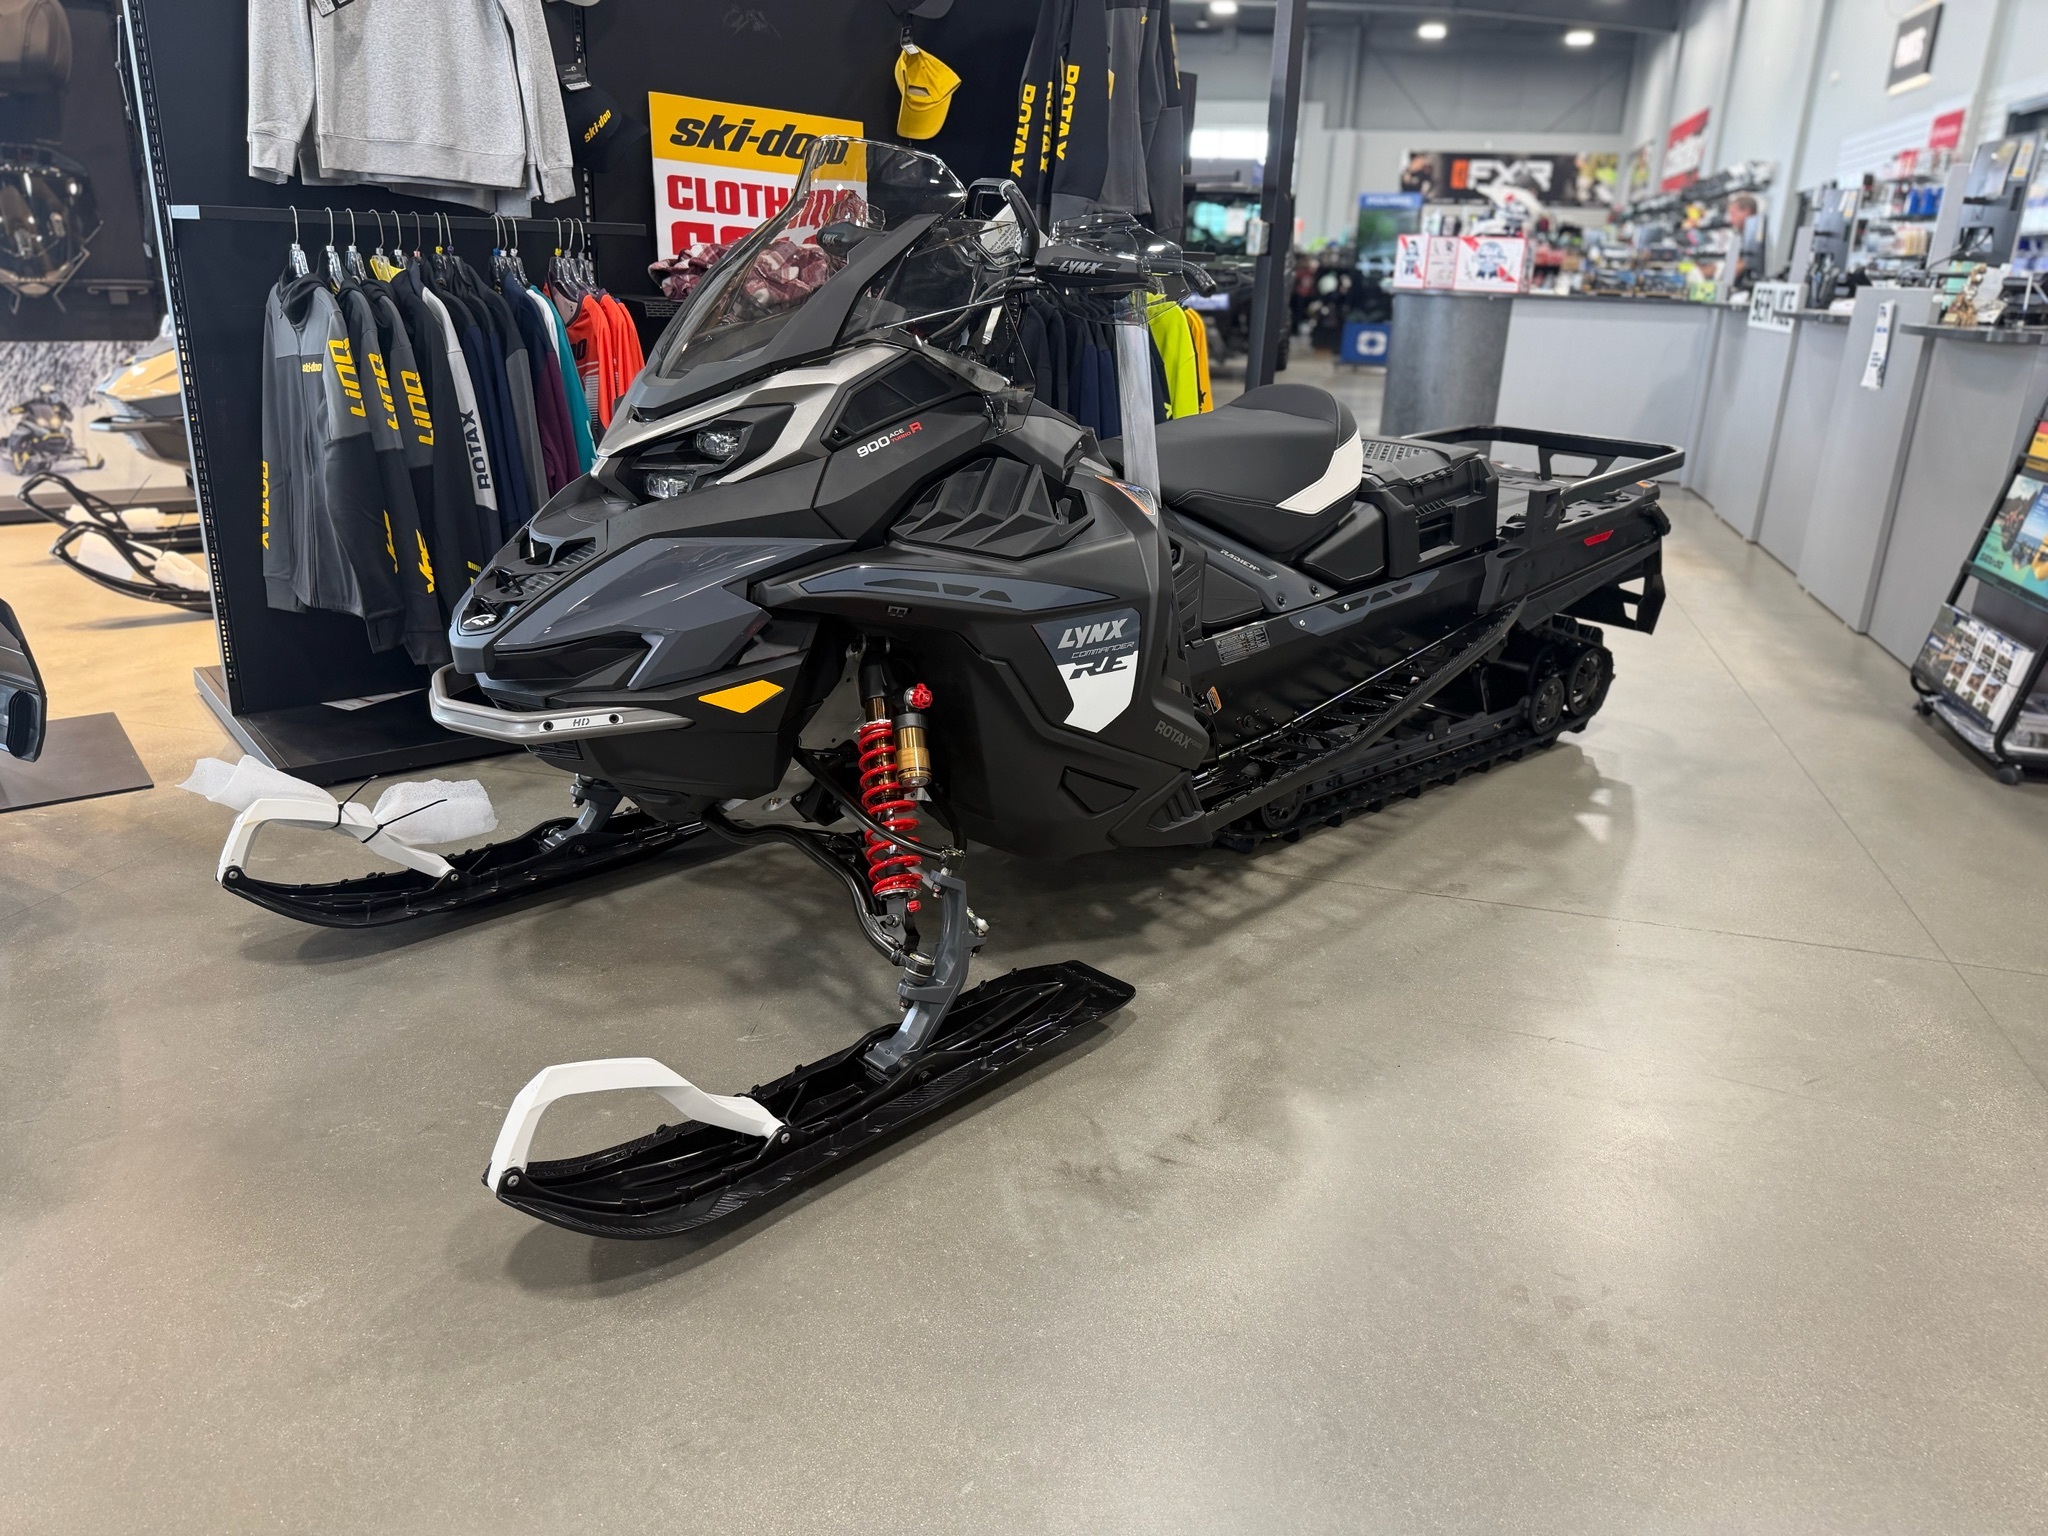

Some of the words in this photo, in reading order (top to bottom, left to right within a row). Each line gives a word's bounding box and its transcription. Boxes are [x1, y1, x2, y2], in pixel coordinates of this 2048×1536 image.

[584, 109, 612, 143] ski-doo
[1058, 260, 1103, 275] LYNX
[460, 409, 491, 490] ROTAX
[856, 435, 890, 457] 900
[889, 427, 904, 439] ACE
[1057, 618, 1129, 649] LYNX
[1071, 641, 1135, 659] COMMANDER
[572, 717, 591, 728] HD
[1154, 719, 1192, 749] ROTAX
